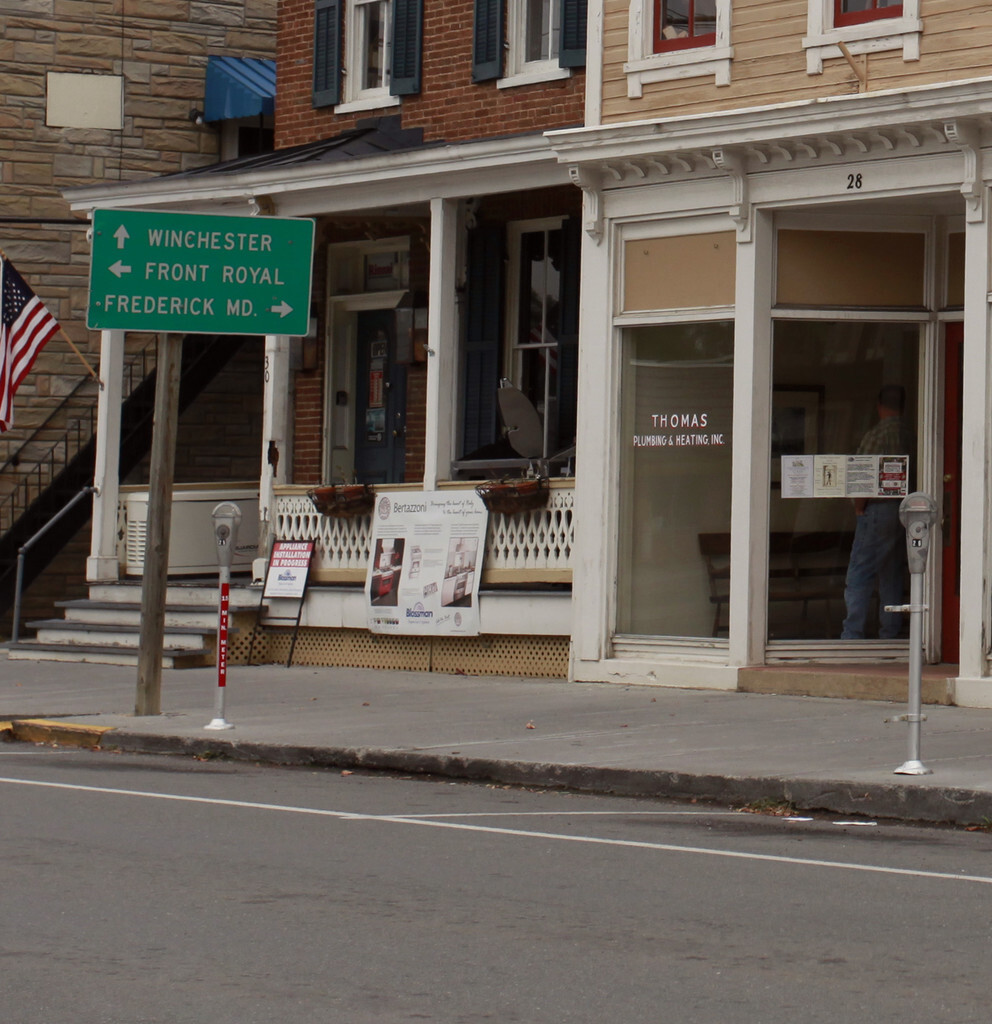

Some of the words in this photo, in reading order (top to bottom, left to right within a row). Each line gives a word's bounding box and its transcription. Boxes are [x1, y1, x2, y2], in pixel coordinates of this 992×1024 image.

[846, 173, 862, 189] 28
[148, 228, 272, 252] WINCHESTER
[144, 262, 210, 282] FRONT
[222, 266, 284, 286] ROYAL
[104, 294, 214, 316] FREDERICK
[226, 299, 258, 317] MD.
[652, 412, 708, 428] THOMAS
[632, 435, 667, 447] PLUMBING
[668, 436, 674, 446] &
[675, 434, 710, 446] HEATING,
[711, 433, 725, 445] INC.
[393, 502, 427, 513] Bertazzoni
[406, 608, 433, 617] Blossman
